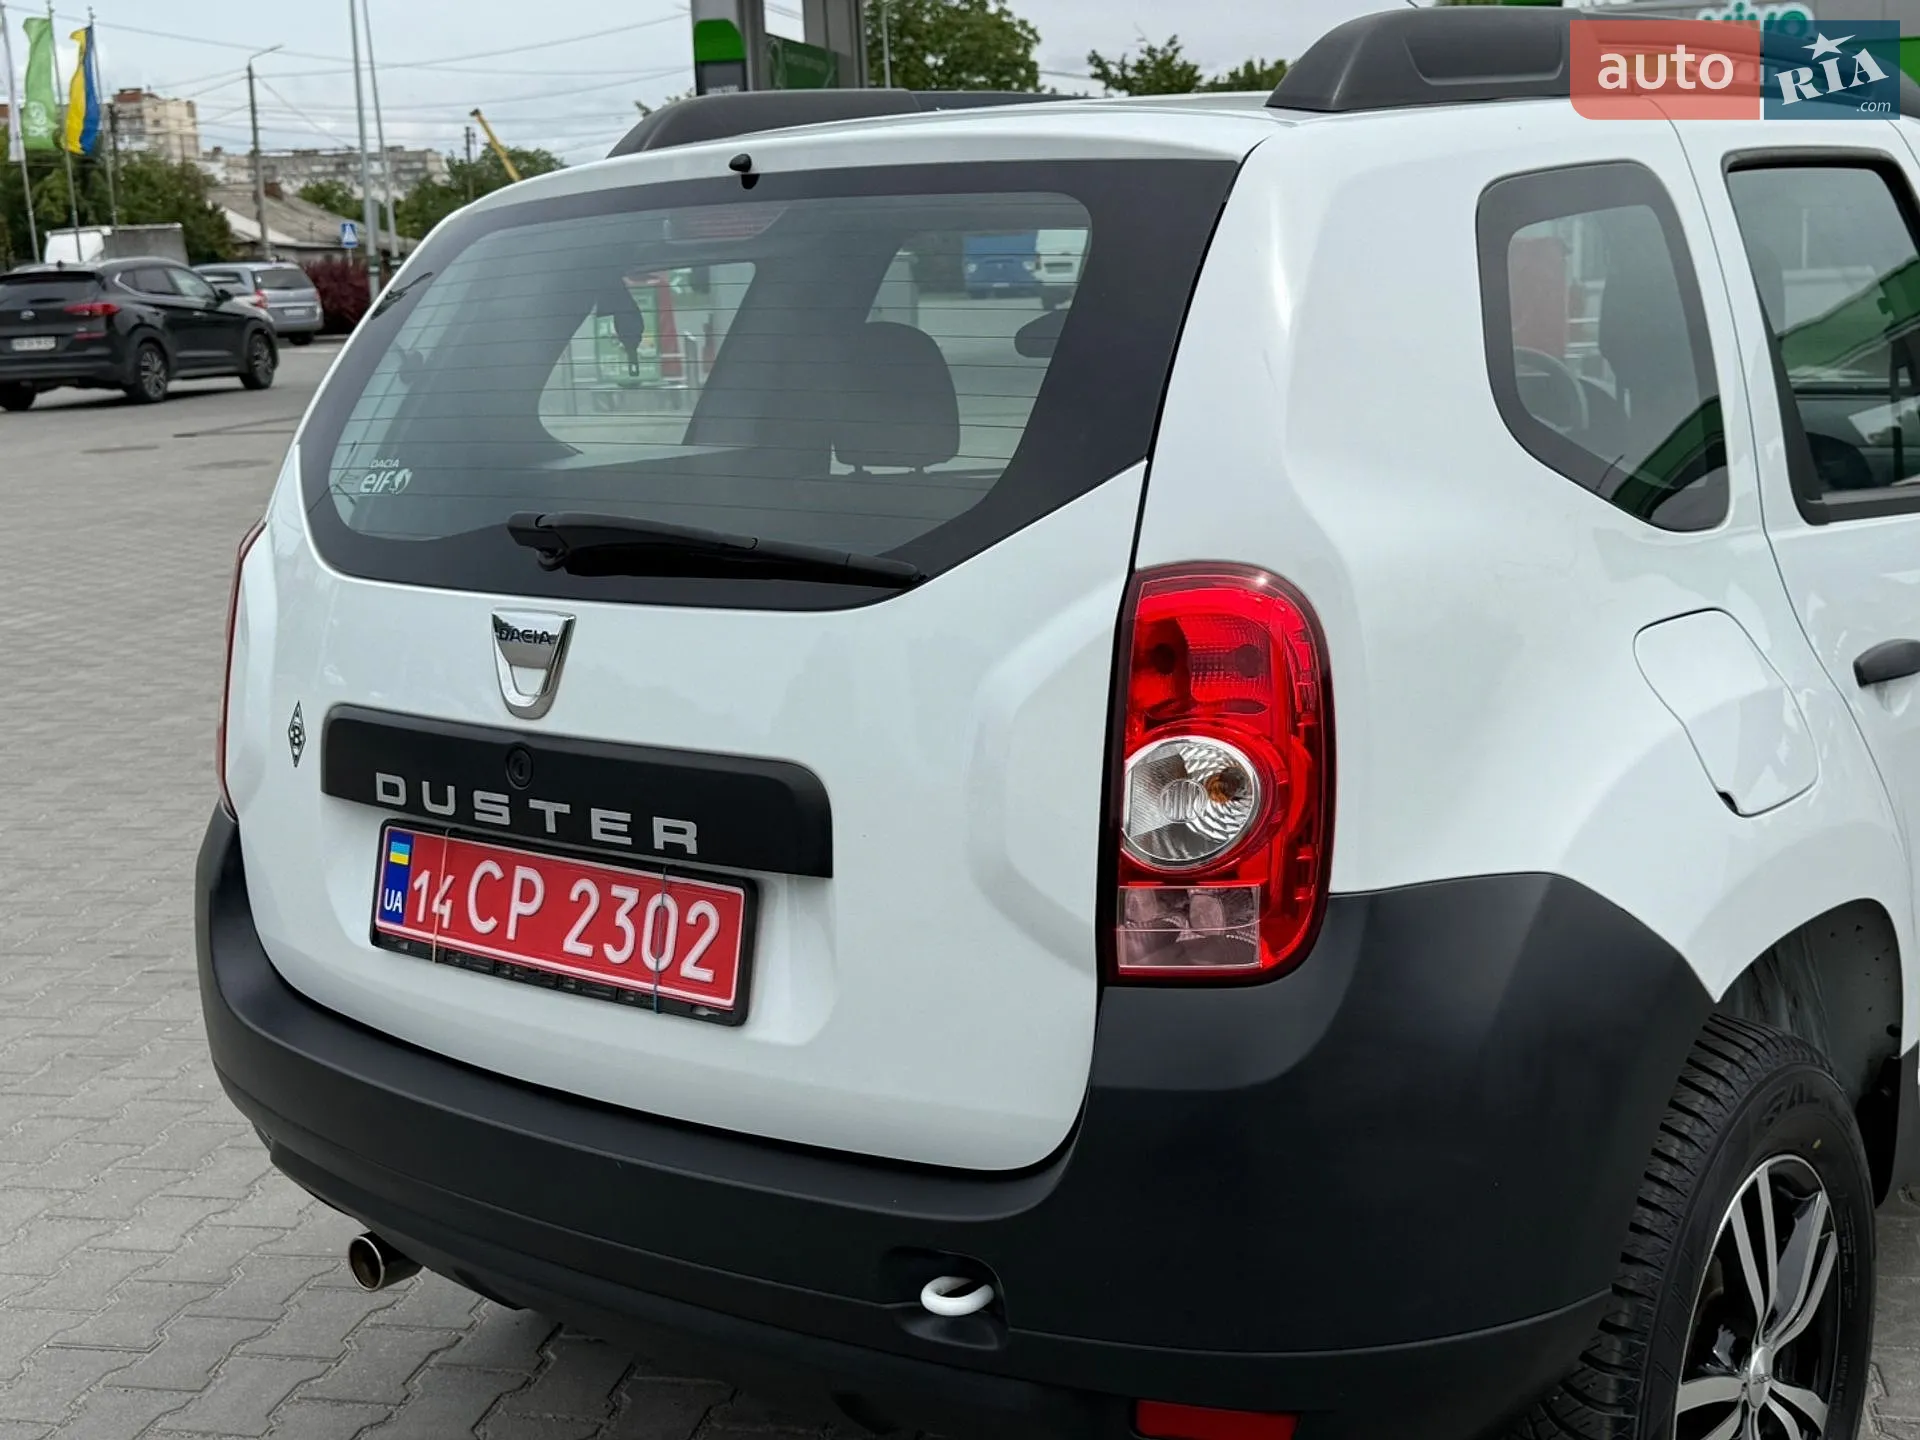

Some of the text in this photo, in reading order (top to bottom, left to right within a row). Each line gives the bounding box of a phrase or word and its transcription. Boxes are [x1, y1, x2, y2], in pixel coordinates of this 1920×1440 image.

[360, 470, 396, 493] elf
[499, 627, 552, 645] DACIA
[375, 771, 699, 855] DUSTER
[383, 887, 403, 914] UA
[413, 860, 720, 983] 14 CP 2302
